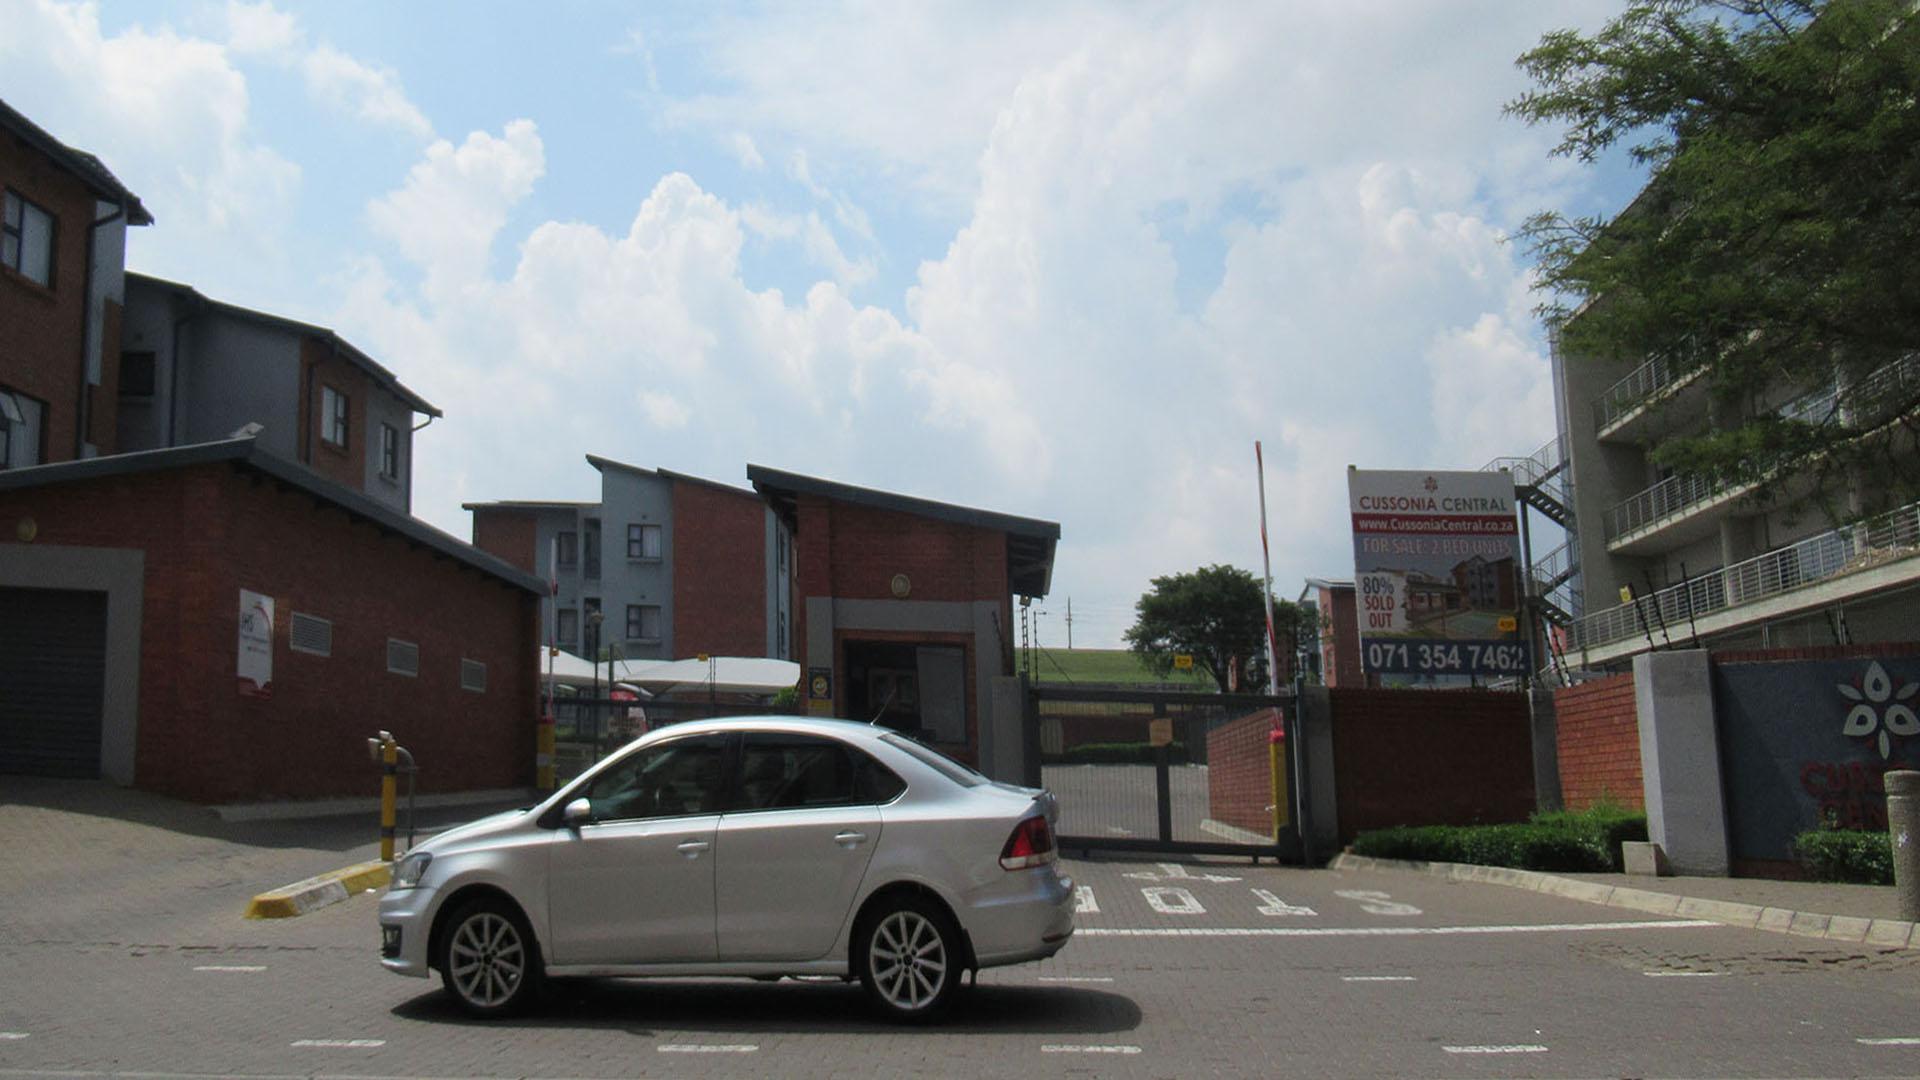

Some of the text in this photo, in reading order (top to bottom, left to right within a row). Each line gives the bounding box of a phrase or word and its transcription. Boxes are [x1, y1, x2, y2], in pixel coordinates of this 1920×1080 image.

[1359, 496, 1507, 512] CUSSONIA CENTRAL
[1359, 518, 1514, 532] www.CussoniaCentral.co.za
[1363, 537, 1388, 553] FOR
[1431, 539, 1440, 554] 2
[1443, 540, 1469, 554] BED
[1472, 540, 1512, 555] UNITS
[1362, 576, 1395, 594] 80%
[1364, 596, 1395, 611] SOLD
[1369, 613, 1393, 628] OUT
[1369, 643, 1526, 670] 071 354 7462
